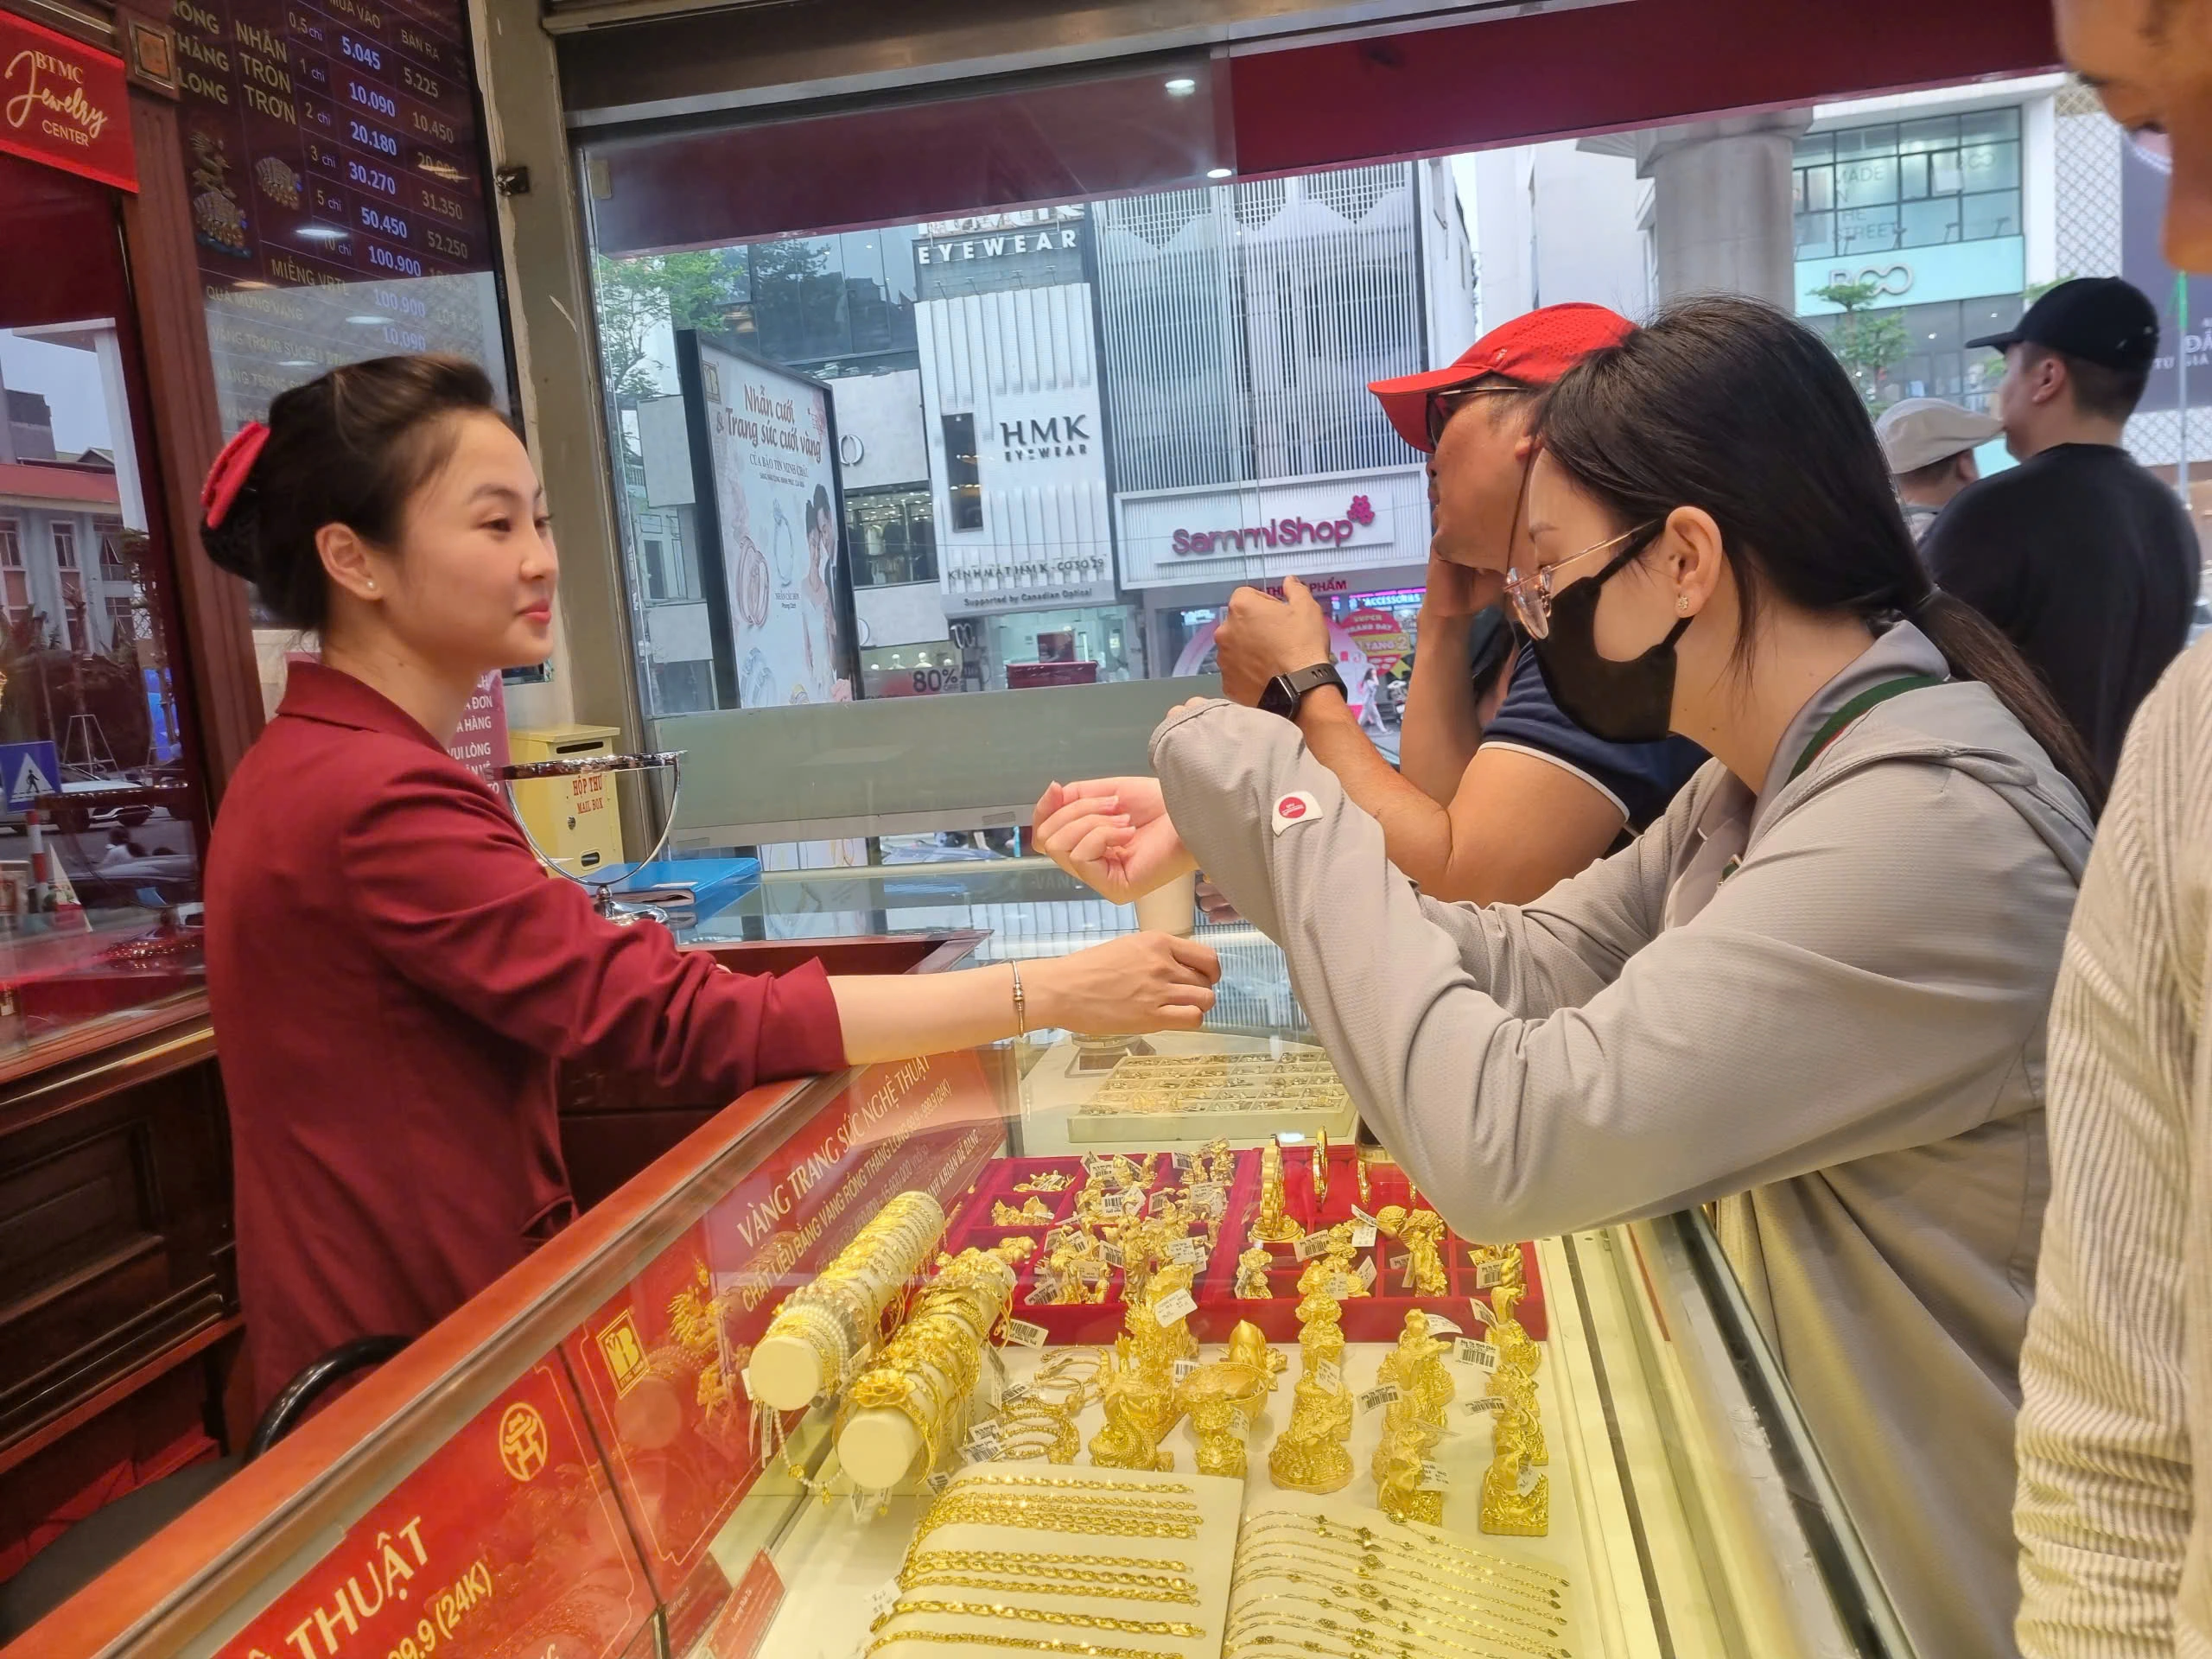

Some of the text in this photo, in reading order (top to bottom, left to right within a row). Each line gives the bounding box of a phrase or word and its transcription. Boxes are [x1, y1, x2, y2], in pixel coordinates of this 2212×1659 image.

[35, 50, 84, 84] BTMC
[341, 35, 381, 71] 5.045
[425, 41, 440, 62] RA
[177, 67, 229, 105] LONG
[239, 52, 291, 94] TRÒN
[300, 57, 326, 83] 1 chi
[404, 66, 439, 99] 5.225
[4, 50, 109, 139] Jewelry
[243, 84, 296, 125] TRƠN
[349, 81, 396, 118] 10.090
[305, 101, 331, 126] 2 chi
[412, 111, 454, 144] 10.450
[41, 119, 90, 147] CENTER
[350, 120, 397, 157] 20.180
[310, 144, 336, 168] 3 chi
[349, 161, 396, 196] 30.270
[317, 189, 342, 213] 5 chi
[422, 189, 463, 221] 31.350
[360, 206, 408, 239] 50.450
[338, 242, 352, 257] chi
[427, 229, 468, 260] 52.250
[918, 229, 1077, 264] EYEWEAR
[367, 245, 422, 278] 100.900
[374, 287, 426, 319] 100.900
[383, 326, 426, 353] 10.090
[744, 384, 795, 424] Nhẫn cưới
[726, 407, 759, 448] Trang
[761, 418, 779, 448] sức
[780, 427, 799, 452] cưới
[800, 430, 822, 465] vàng
[999, 414, 1090, 448] HMK
[1004, 443, 1088, 463] EYEWEAR
[1014, 563, 1049, 575] HMK
[1309, 576, 1348, 594] PHẨM
[964, 588, 1093, 607] Supported by Canadian Optical
[1395, 635, 1408, 651] 2
[912, 668, 958, 693] 80%
[472, 696, 493, 710] ĐƠN
[465, 715, 492, 732] HÀNG
[465, 741, 491, 760] LÒNG
[577, 797, 604, 815] MAIL BOX
[736, 1185, 792, 1249] VÀNG
[787, 1136, 841, 1202] TRANG
[836, 1113, 867, 1154] SỨC
[861, 1076, 901, 1128] NGHỆ
[792, 1217, 823, 1259] BẰNG
[818, 1200, 846, 1230] VÀNG
[843, 1172, 869, 1210] RỒNG
[864, 1147, 893, 1180] THĂNG
[285, 1516, 430, 1659] THUẬT
[436, 1560, 492, 1641] (24K)
